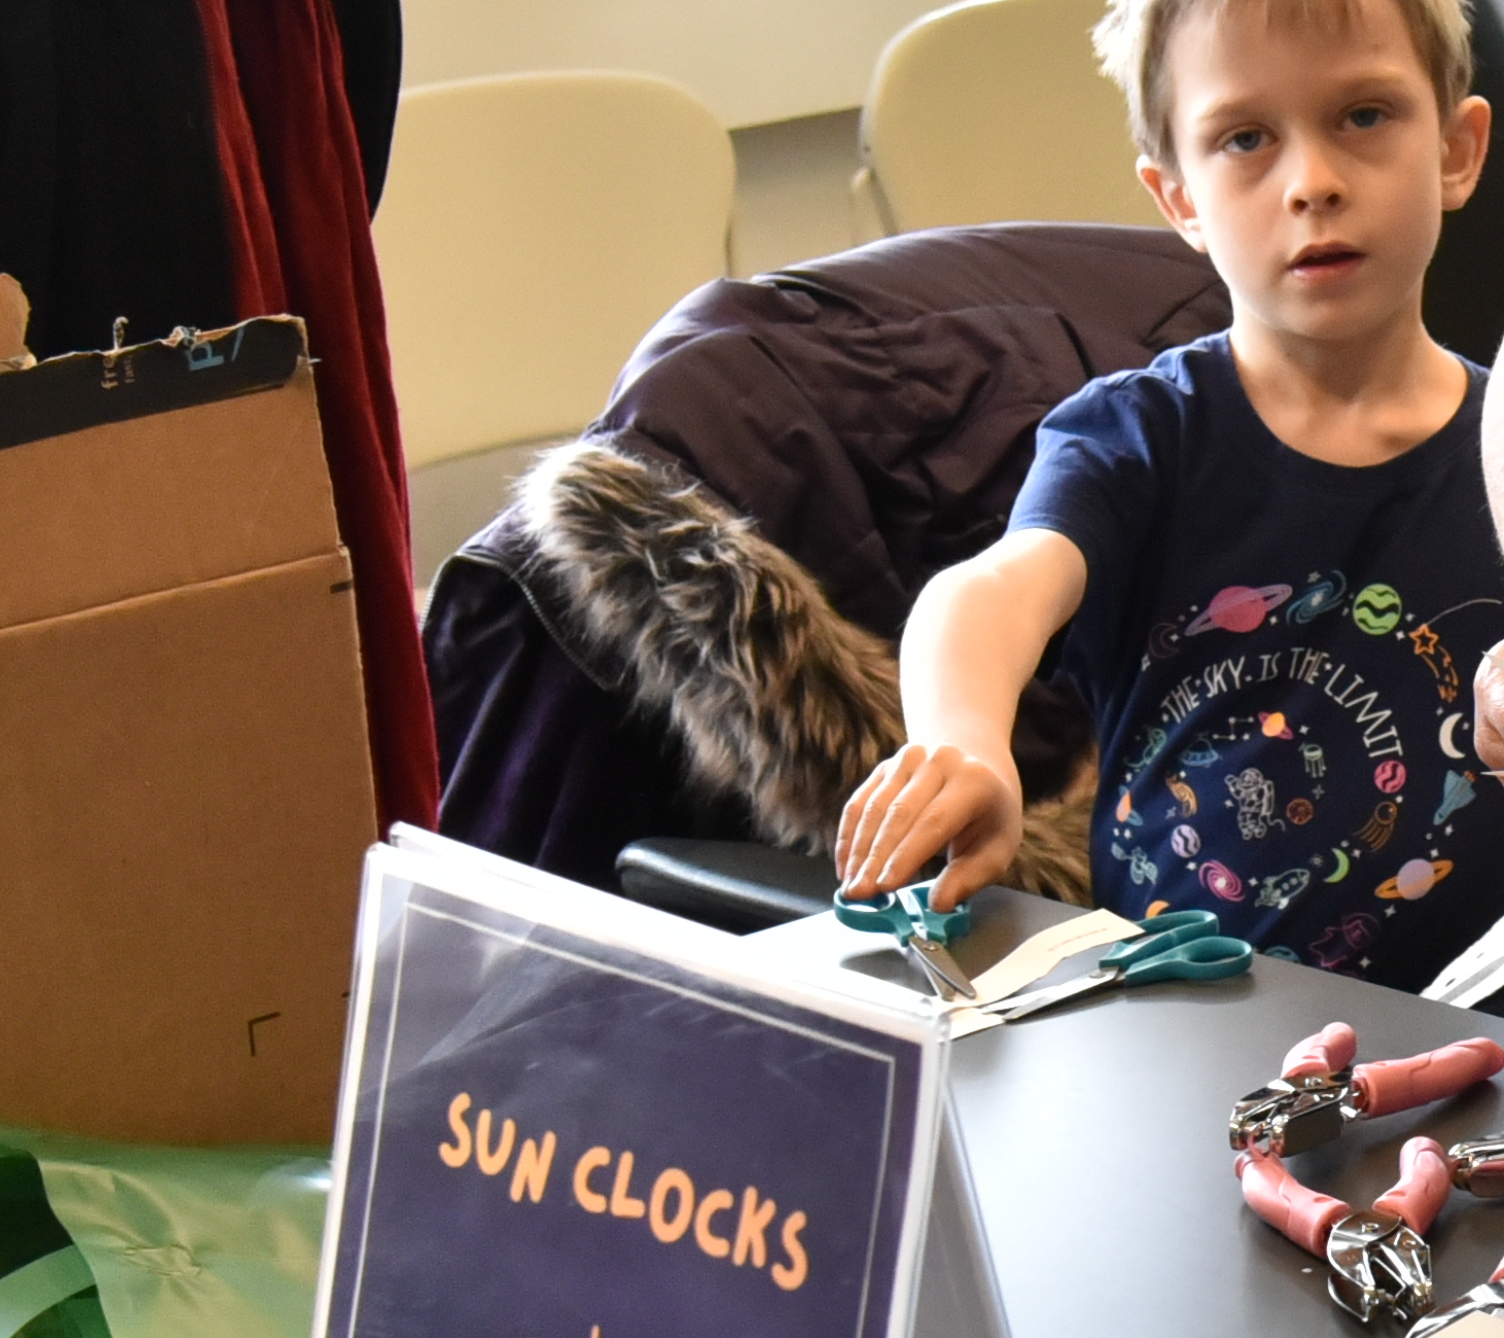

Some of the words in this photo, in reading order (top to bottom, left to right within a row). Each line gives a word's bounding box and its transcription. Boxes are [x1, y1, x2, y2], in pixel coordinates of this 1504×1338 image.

[1162, 673, 1201, 724] THE
[1203, 656, 1245, 698] SKY
[1256, 651, 1280, 684] IS
[1289, 646, 1329, 685] THE
[1323, 663, 1404, 759] LIMIT
[439, 1091, 557, 1204] SUN
[572, 1145, 808, 1291] CLOCKS
